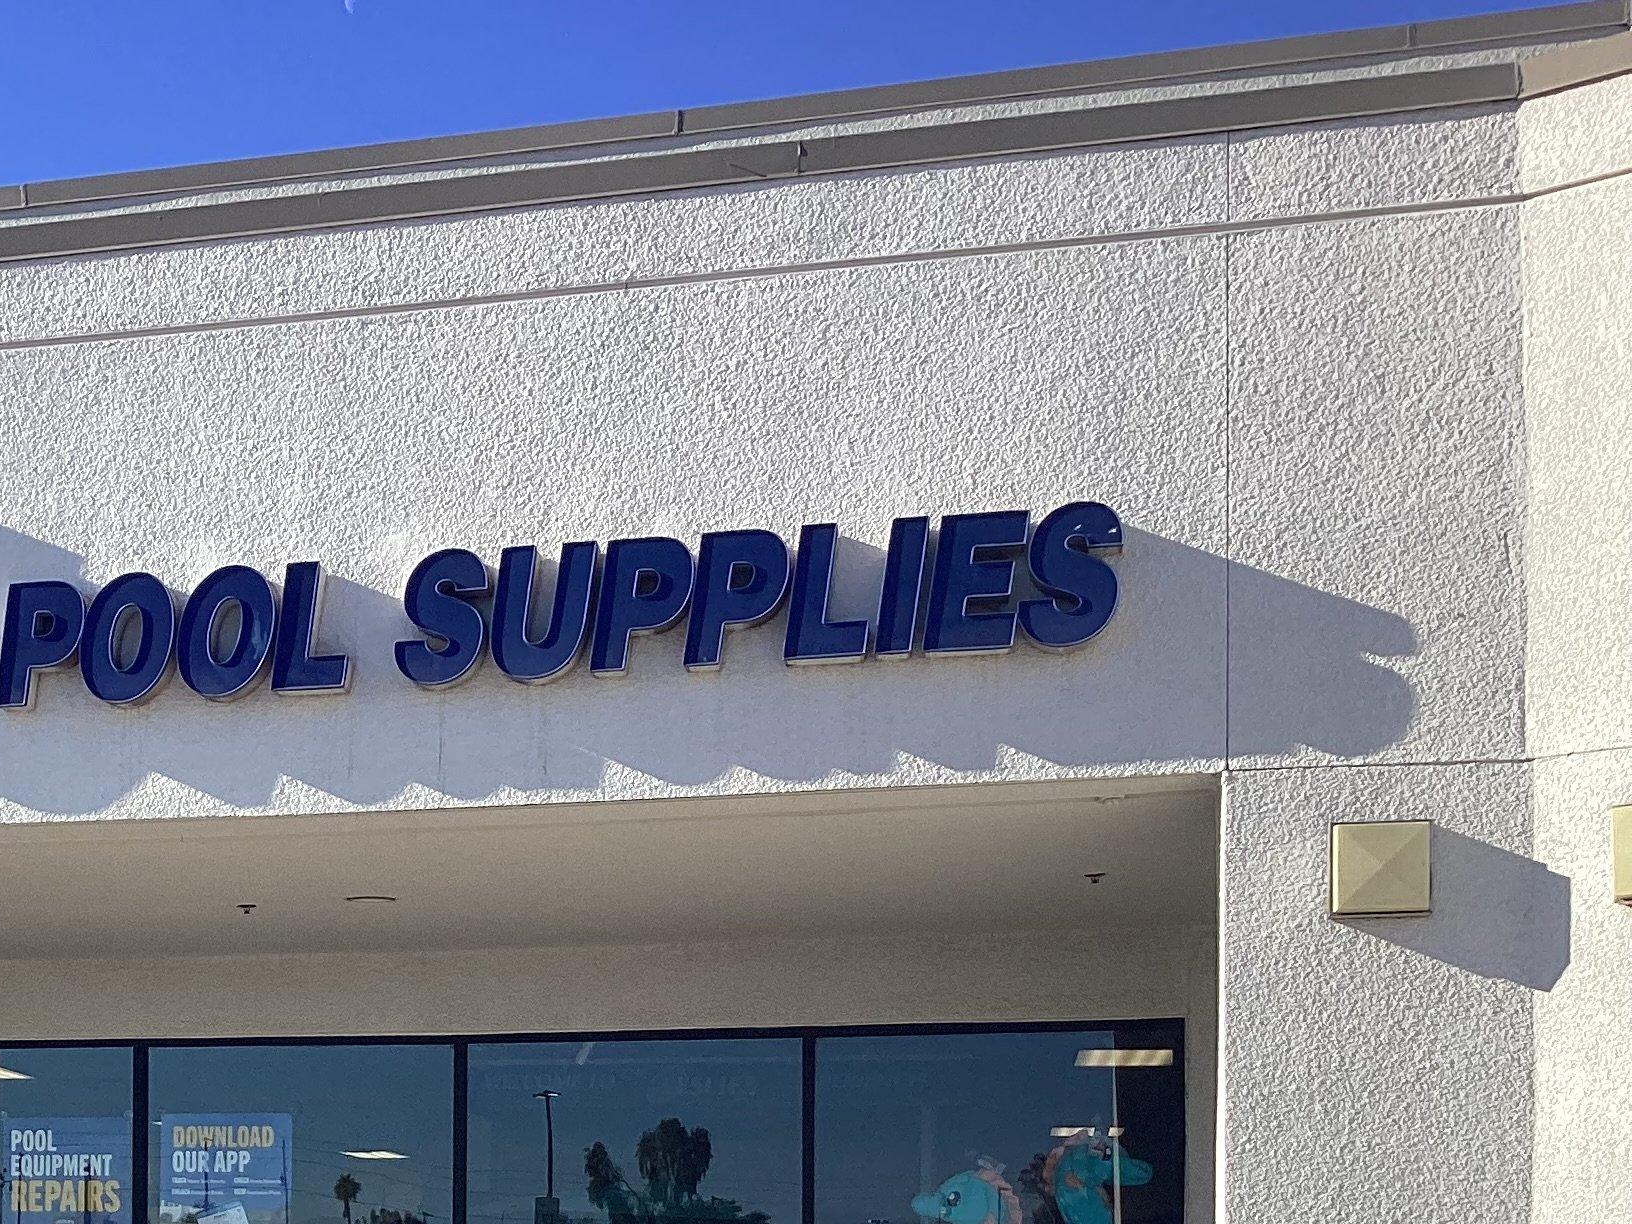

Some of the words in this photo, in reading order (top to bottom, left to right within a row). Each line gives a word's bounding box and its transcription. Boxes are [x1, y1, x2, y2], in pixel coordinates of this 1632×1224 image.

[393, 500, 1126, 688] SUPPLIES
[10, 1129, 58, 1152] POOL
[172, 1125, 276, 1148] DOWNLOAD
[10, 1154, 113, 1177] EQUIPMENT
[171, 1150, 210, 1173] OUR
[213, 1150, 251, 1173] APP
[10, 1180, 122, 1213] REPAIRS
